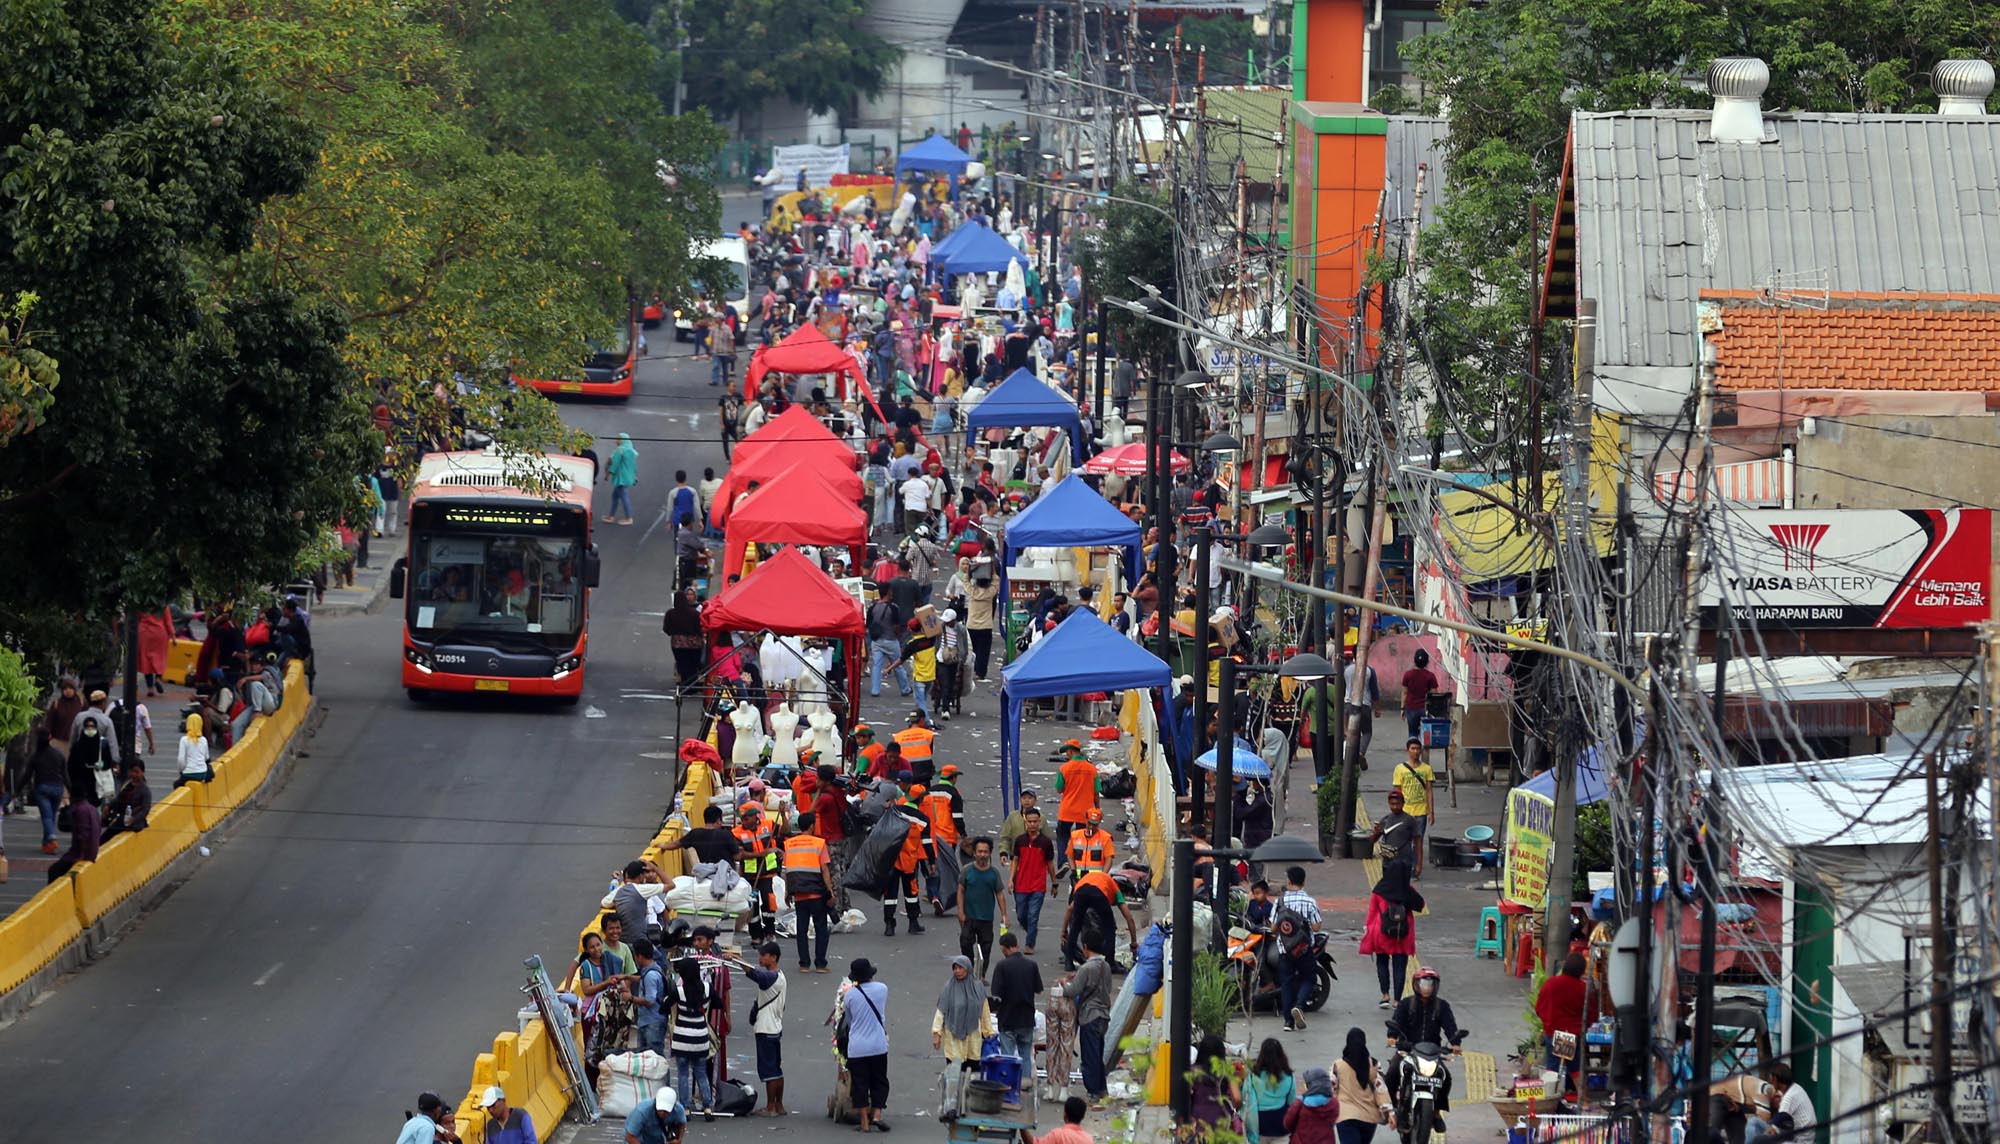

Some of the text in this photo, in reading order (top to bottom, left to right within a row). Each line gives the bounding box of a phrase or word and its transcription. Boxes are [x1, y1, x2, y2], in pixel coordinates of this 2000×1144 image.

[1796, 577, 1877, 590] BATTERY
[1919, 579, 1981, 594] Memang
[1914, 593, 1986, 606] Lebih Baik
[1756, 608, 1809, 619] HARAPAN
[1811, 608, 1843, 619] BARU
[435, 654, 466, 663] TJ0514
[1518, 1087, 1544, 1098] 15.000
